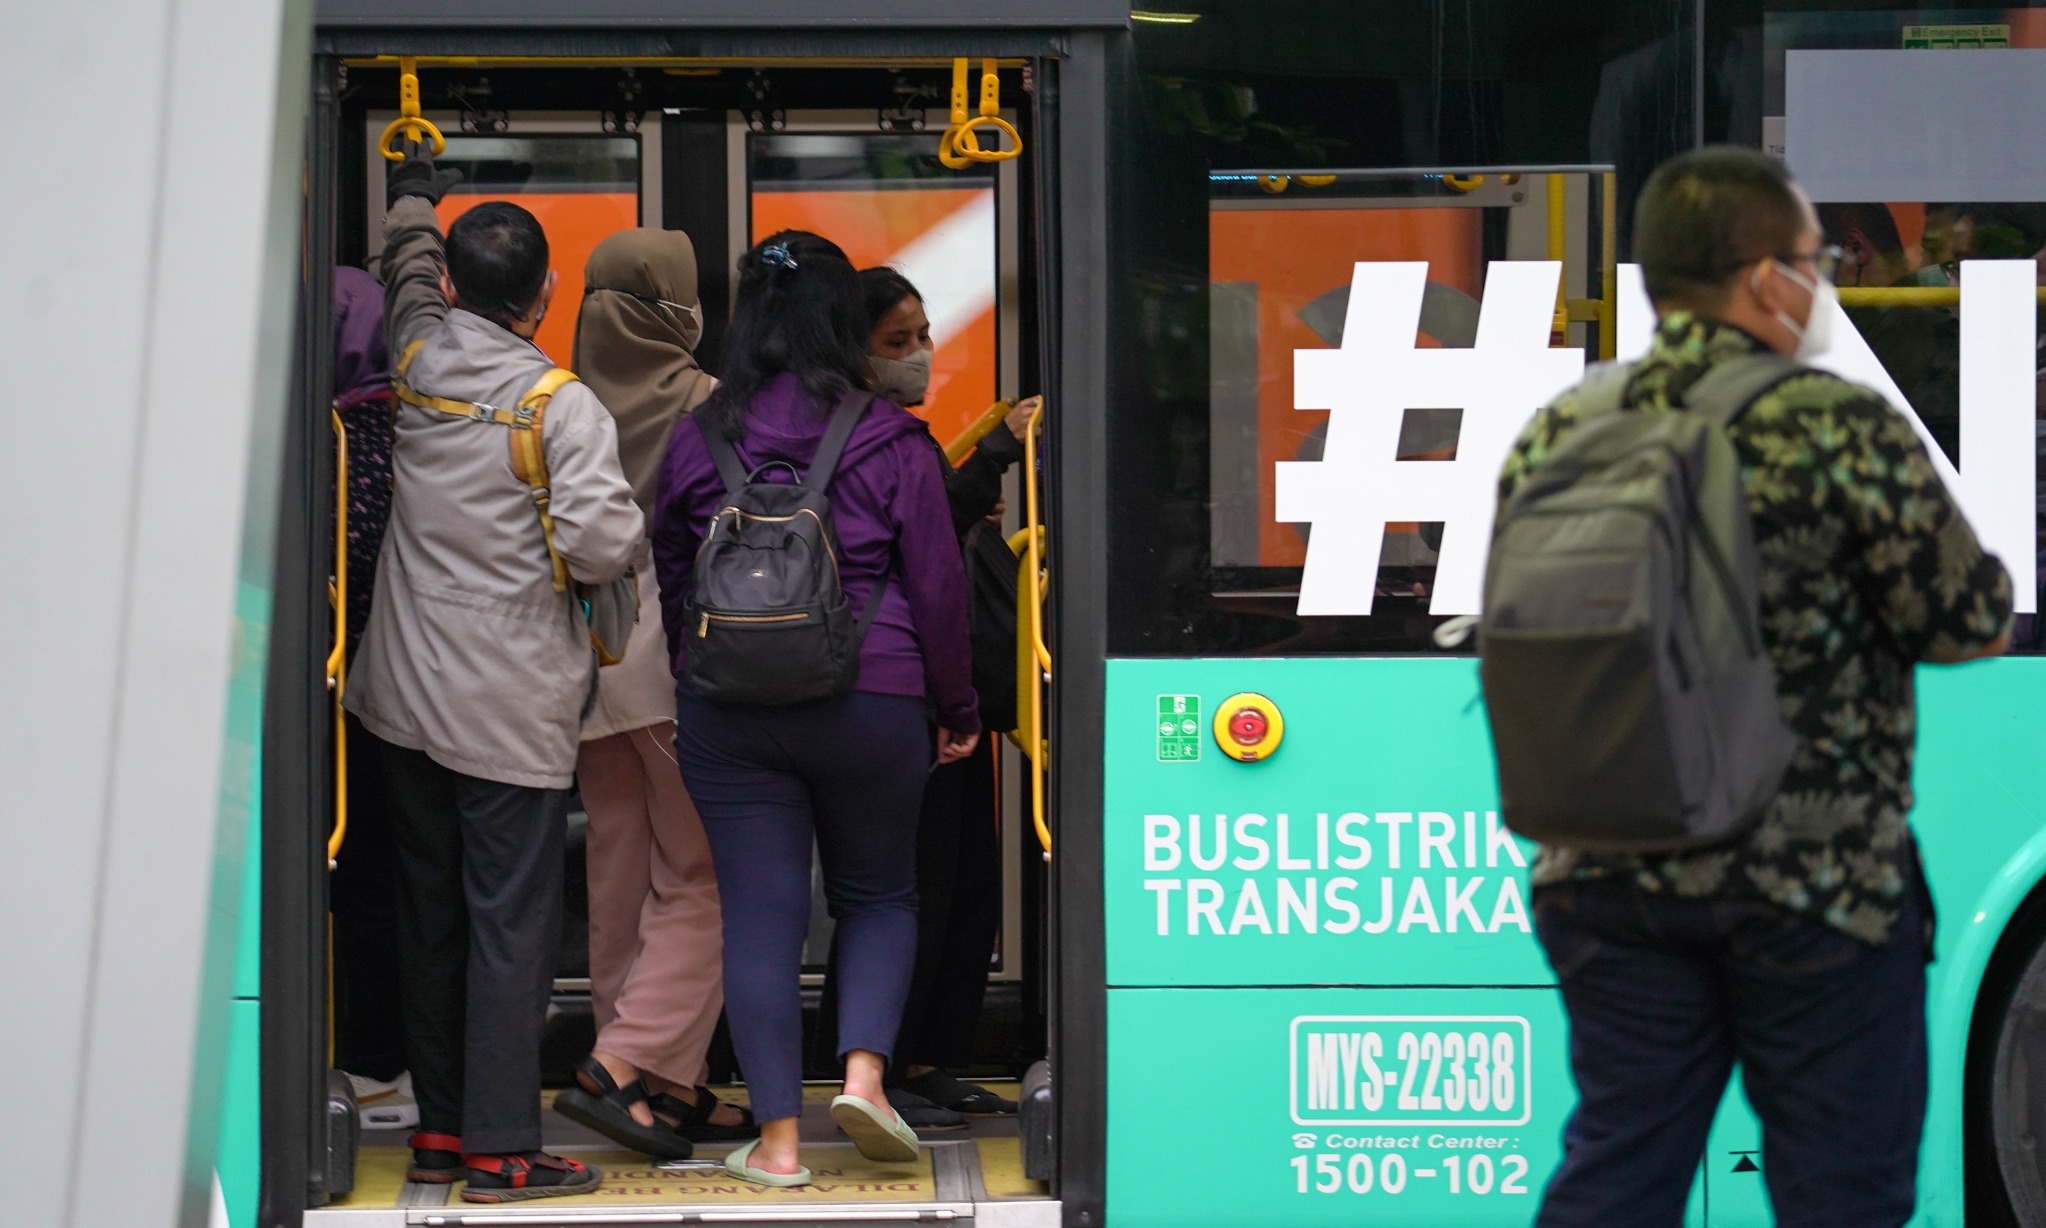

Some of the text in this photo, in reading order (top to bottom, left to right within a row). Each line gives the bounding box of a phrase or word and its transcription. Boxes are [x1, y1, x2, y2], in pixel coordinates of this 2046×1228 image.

[1922, 27, 2002, 38] Emergency Exit
[1768, 145, 1786, 154] Tid
[1143, 876, 1533, 936] TRANSJAKA
[1307, 1032, 1515, 1112] MYS-22338
[1325, 1133, 1420, 1149] Contact
[1290, 1153, 1529, 1195] 1500-102
